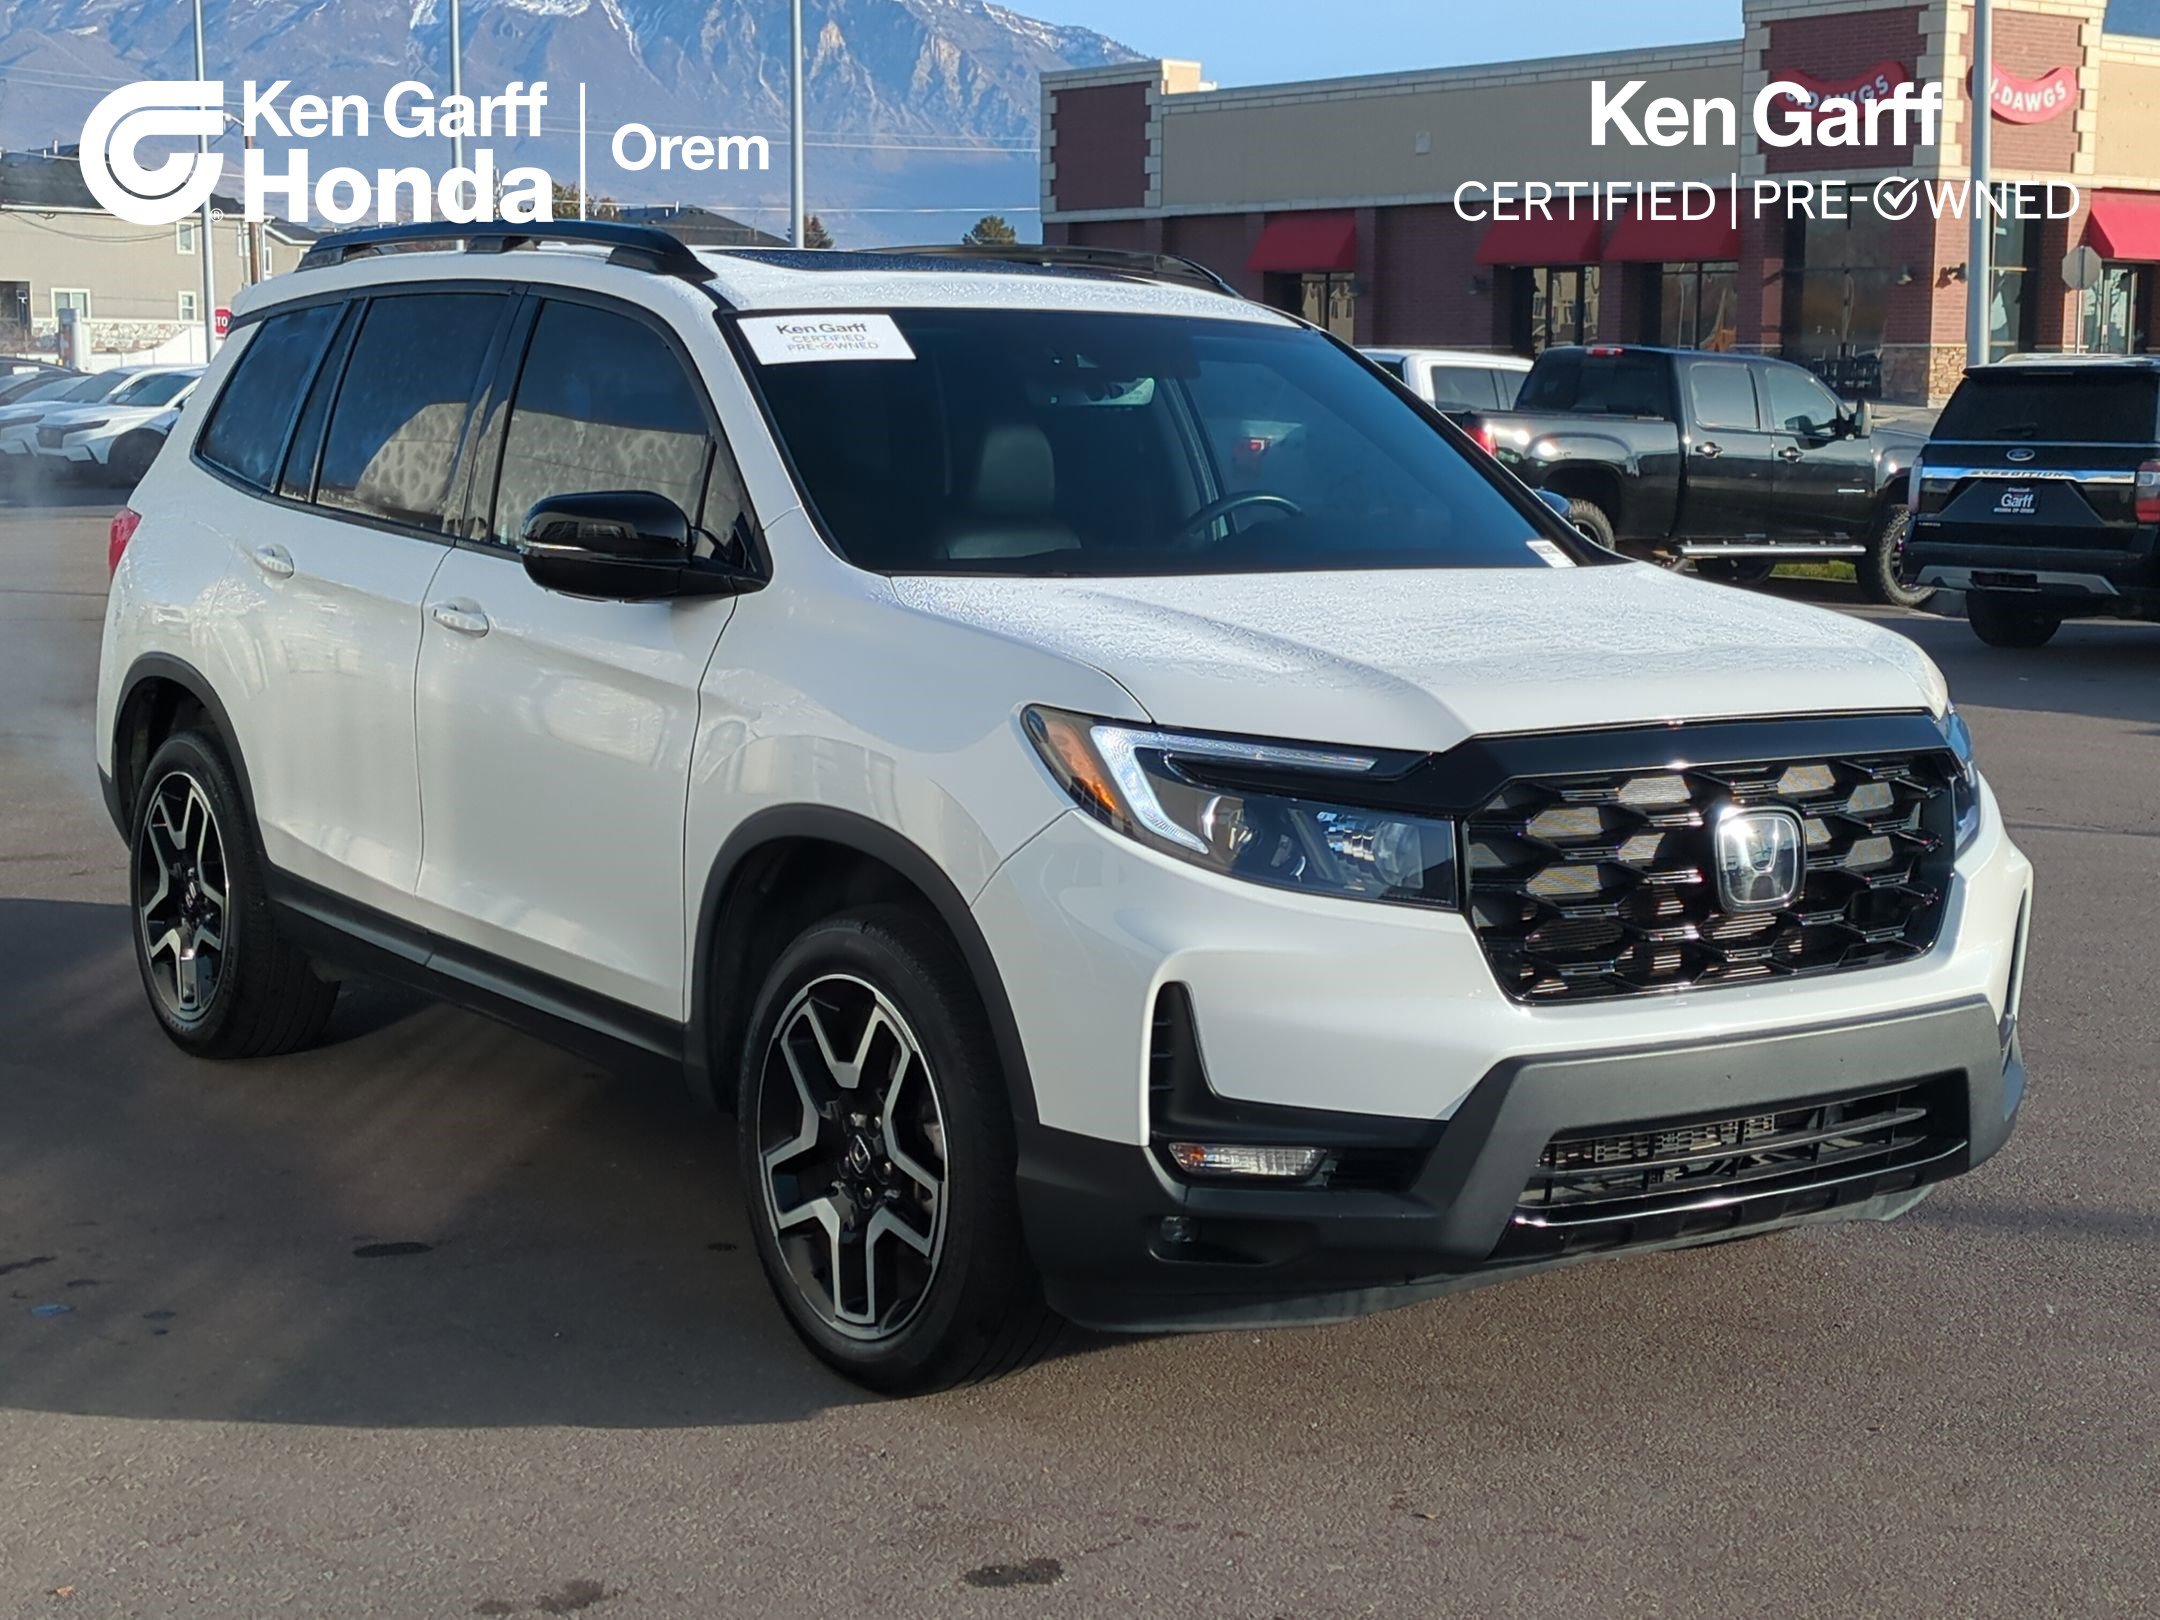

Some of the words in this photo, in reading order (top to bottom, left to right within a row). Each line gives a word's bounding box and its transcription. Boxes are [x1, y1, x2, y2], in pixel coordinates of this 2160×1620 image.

[216, 315, 228, 327] TO
[776, 324, 816, 335] Ken
[820, 323, 867, 334] Garff
[791, 334, 866, 344] CERTIFIED
[2001, 493, 2034, 508] Garff
